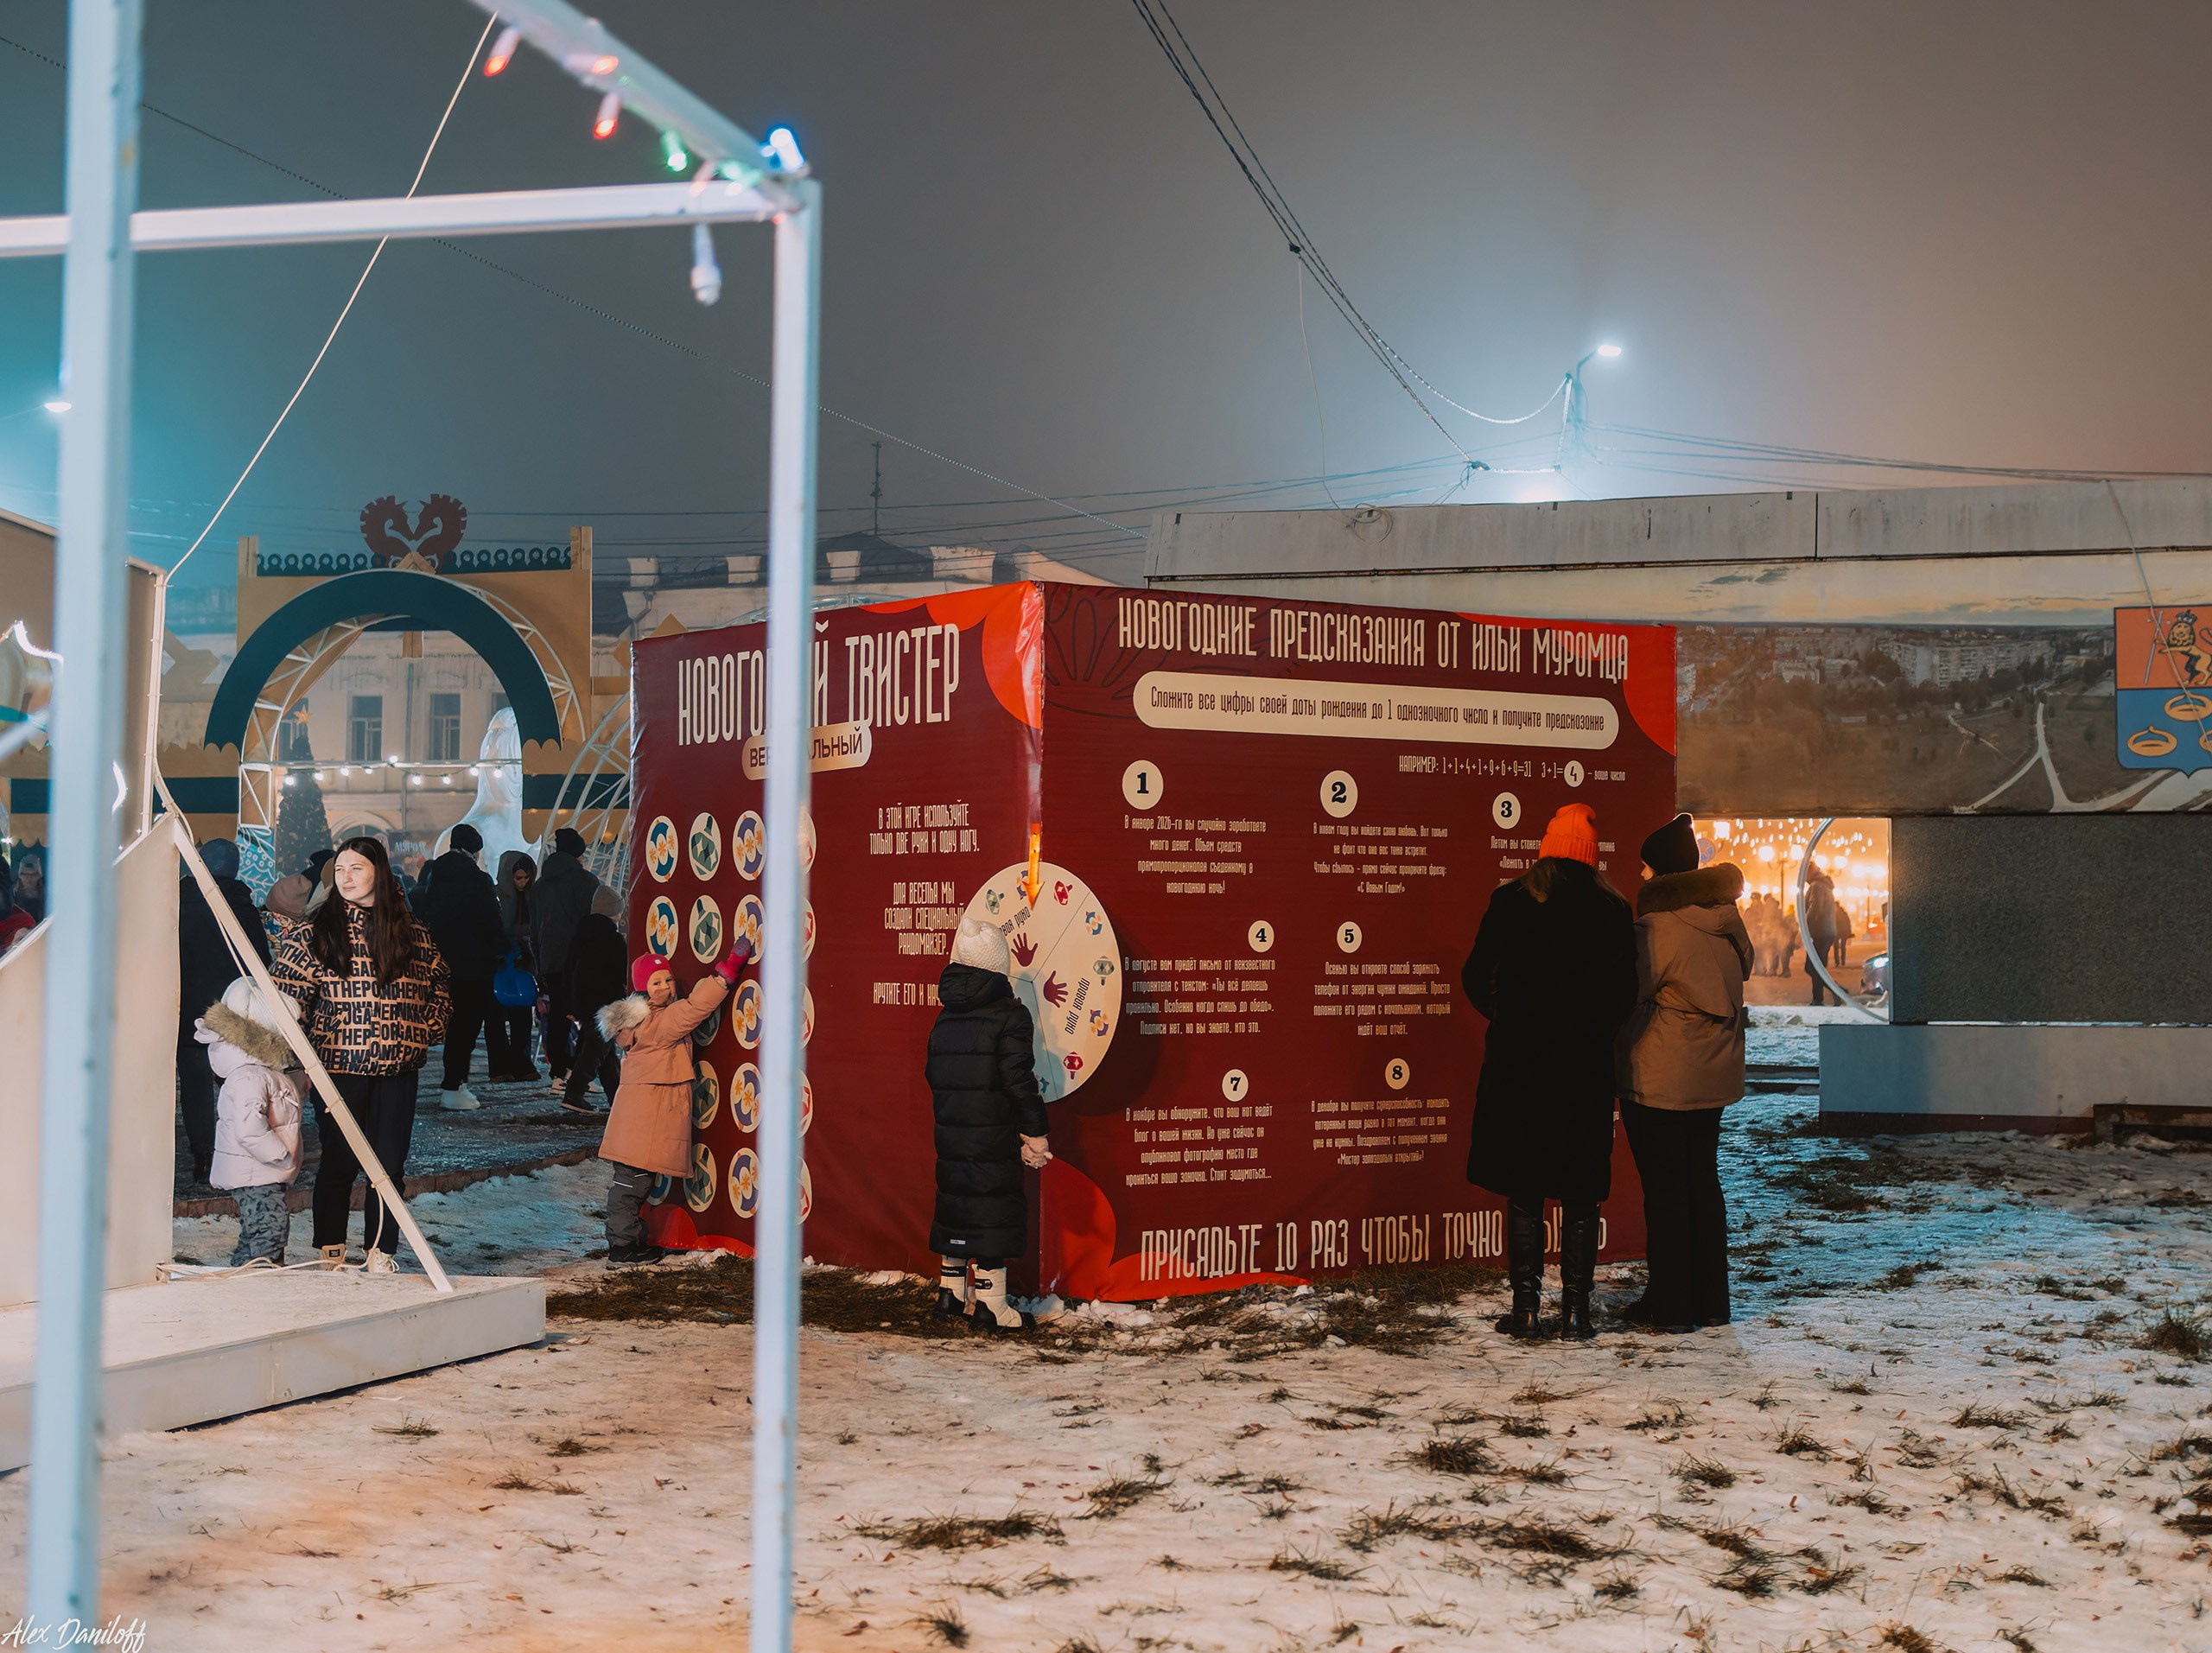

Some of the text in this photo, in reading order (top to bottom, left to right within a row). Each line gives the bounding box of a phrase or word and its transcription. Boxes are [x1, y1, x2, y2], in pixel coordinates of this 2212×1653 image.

[1119, 597, 1628, 683] НОВОГОДНИЕ ПРЕДСКАЗАНИЯ ОТ ИЛЬИ МУРОМЦА
[678, 620, 959, 746] НОВОГОЙ ТВИСТЕР
[1152, 686, 1604, 731] Сложите все цифры своей даты рождения до 1 однозначного числа и получите предсказание
[1399, 755, 1439, 773] НАПРИМЕР:
[1570, 766, 1578, 782] 4
[1137, 772, 1148, 793] 1
[1332, 782, 1346, 803] 2
[879, 799, 969, 830] В ЭТОЙ ИГРЕ ИСПОЛЬЗУЙТЕ
[1501, 801, 1512, 817] 3
[1125, 815, 1266, 833] В январе 2026-го вы случайно заработаете
[869, 830, 979, 855] ТОЛЬКО ДВЕ РУКИ И ОДНУ НОГУ.
[1150, 838, 1242, 854] много денег. Объем средств
[893, 881, 954, 905] ДЛЯ ВЕСЕЛЬЯ МЫ
[885, 903, 964, 931] СОЗДАЛИ СПЕЦИАЛЬНЫЙ
[1255, 928, 1267, 942] 4
[1344, 929, 1354, 943] 5
[1125, 957, 1274, 973] В августе вам придёт письмо от неизвестного
[874, 982, 900, 1005] КРУТИТЕ
[904, 983, 916, 1005] ЕГО
[919, 983, 924, 1006] И
[1392, 1065, 1402, 1079] 8
[1230, 1077, 1241, 1091] 7
[1126, 1108, 1130, 1122] В
[1134, 1107, 1155, 1122] ноябре
[1158, 1109, 1167, 1120] вы
[1214, 1108, 1224, 1118] что
[1227, 1107, 1239, 1117] ваш
[1243, 1107, 1252, 1116] кот
[1255, 1103, 1273, 1116] ведёт
[1141, 1224, 1261, 1281] ПРИСЯДЬТЕ
[1275, 1222, 1297, 1271] 10
[1311, 1219, 1348, 1268] РАЗ
[1361, 1213, 1430, 1265] ЧТОБЫ
[1443, 1211, 1503, 1259] ТОЧНО
